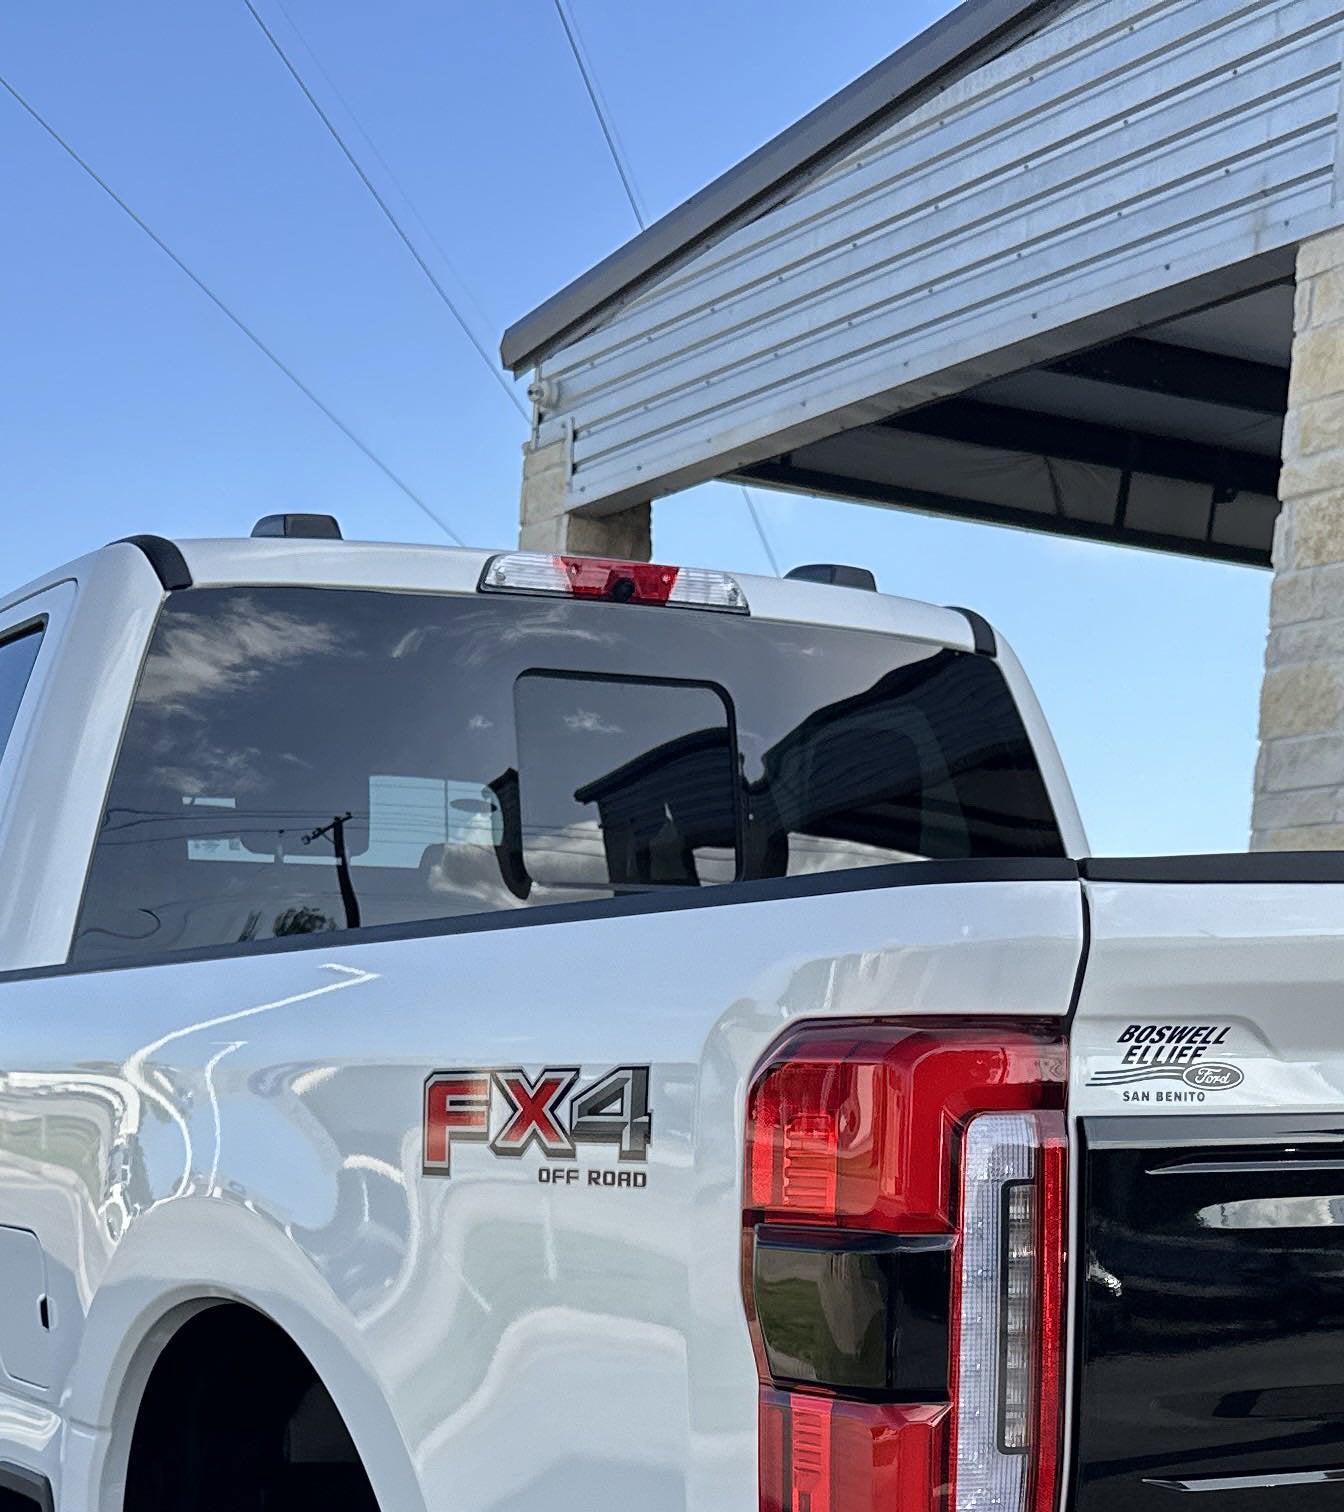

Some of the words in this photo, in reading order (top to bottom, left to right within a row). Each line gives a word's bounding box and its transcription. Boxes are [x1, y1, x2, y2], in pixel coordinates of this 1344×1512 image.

[1117, 1024, 1231, 1045] BOSWELL
[1121, 1045, 1207, 1065] ELLIFF
[1194, 1067, 1232, 1085] Ford
[1122, 1091, 1150, 1102] SAN
[1155, 1091, 1206, 1102] BENITO
[422, 1064, 654, 1178] FX4
[538, 1167, 579, 1185] OFF
[587, 1168, 648, 1188] ROAD
